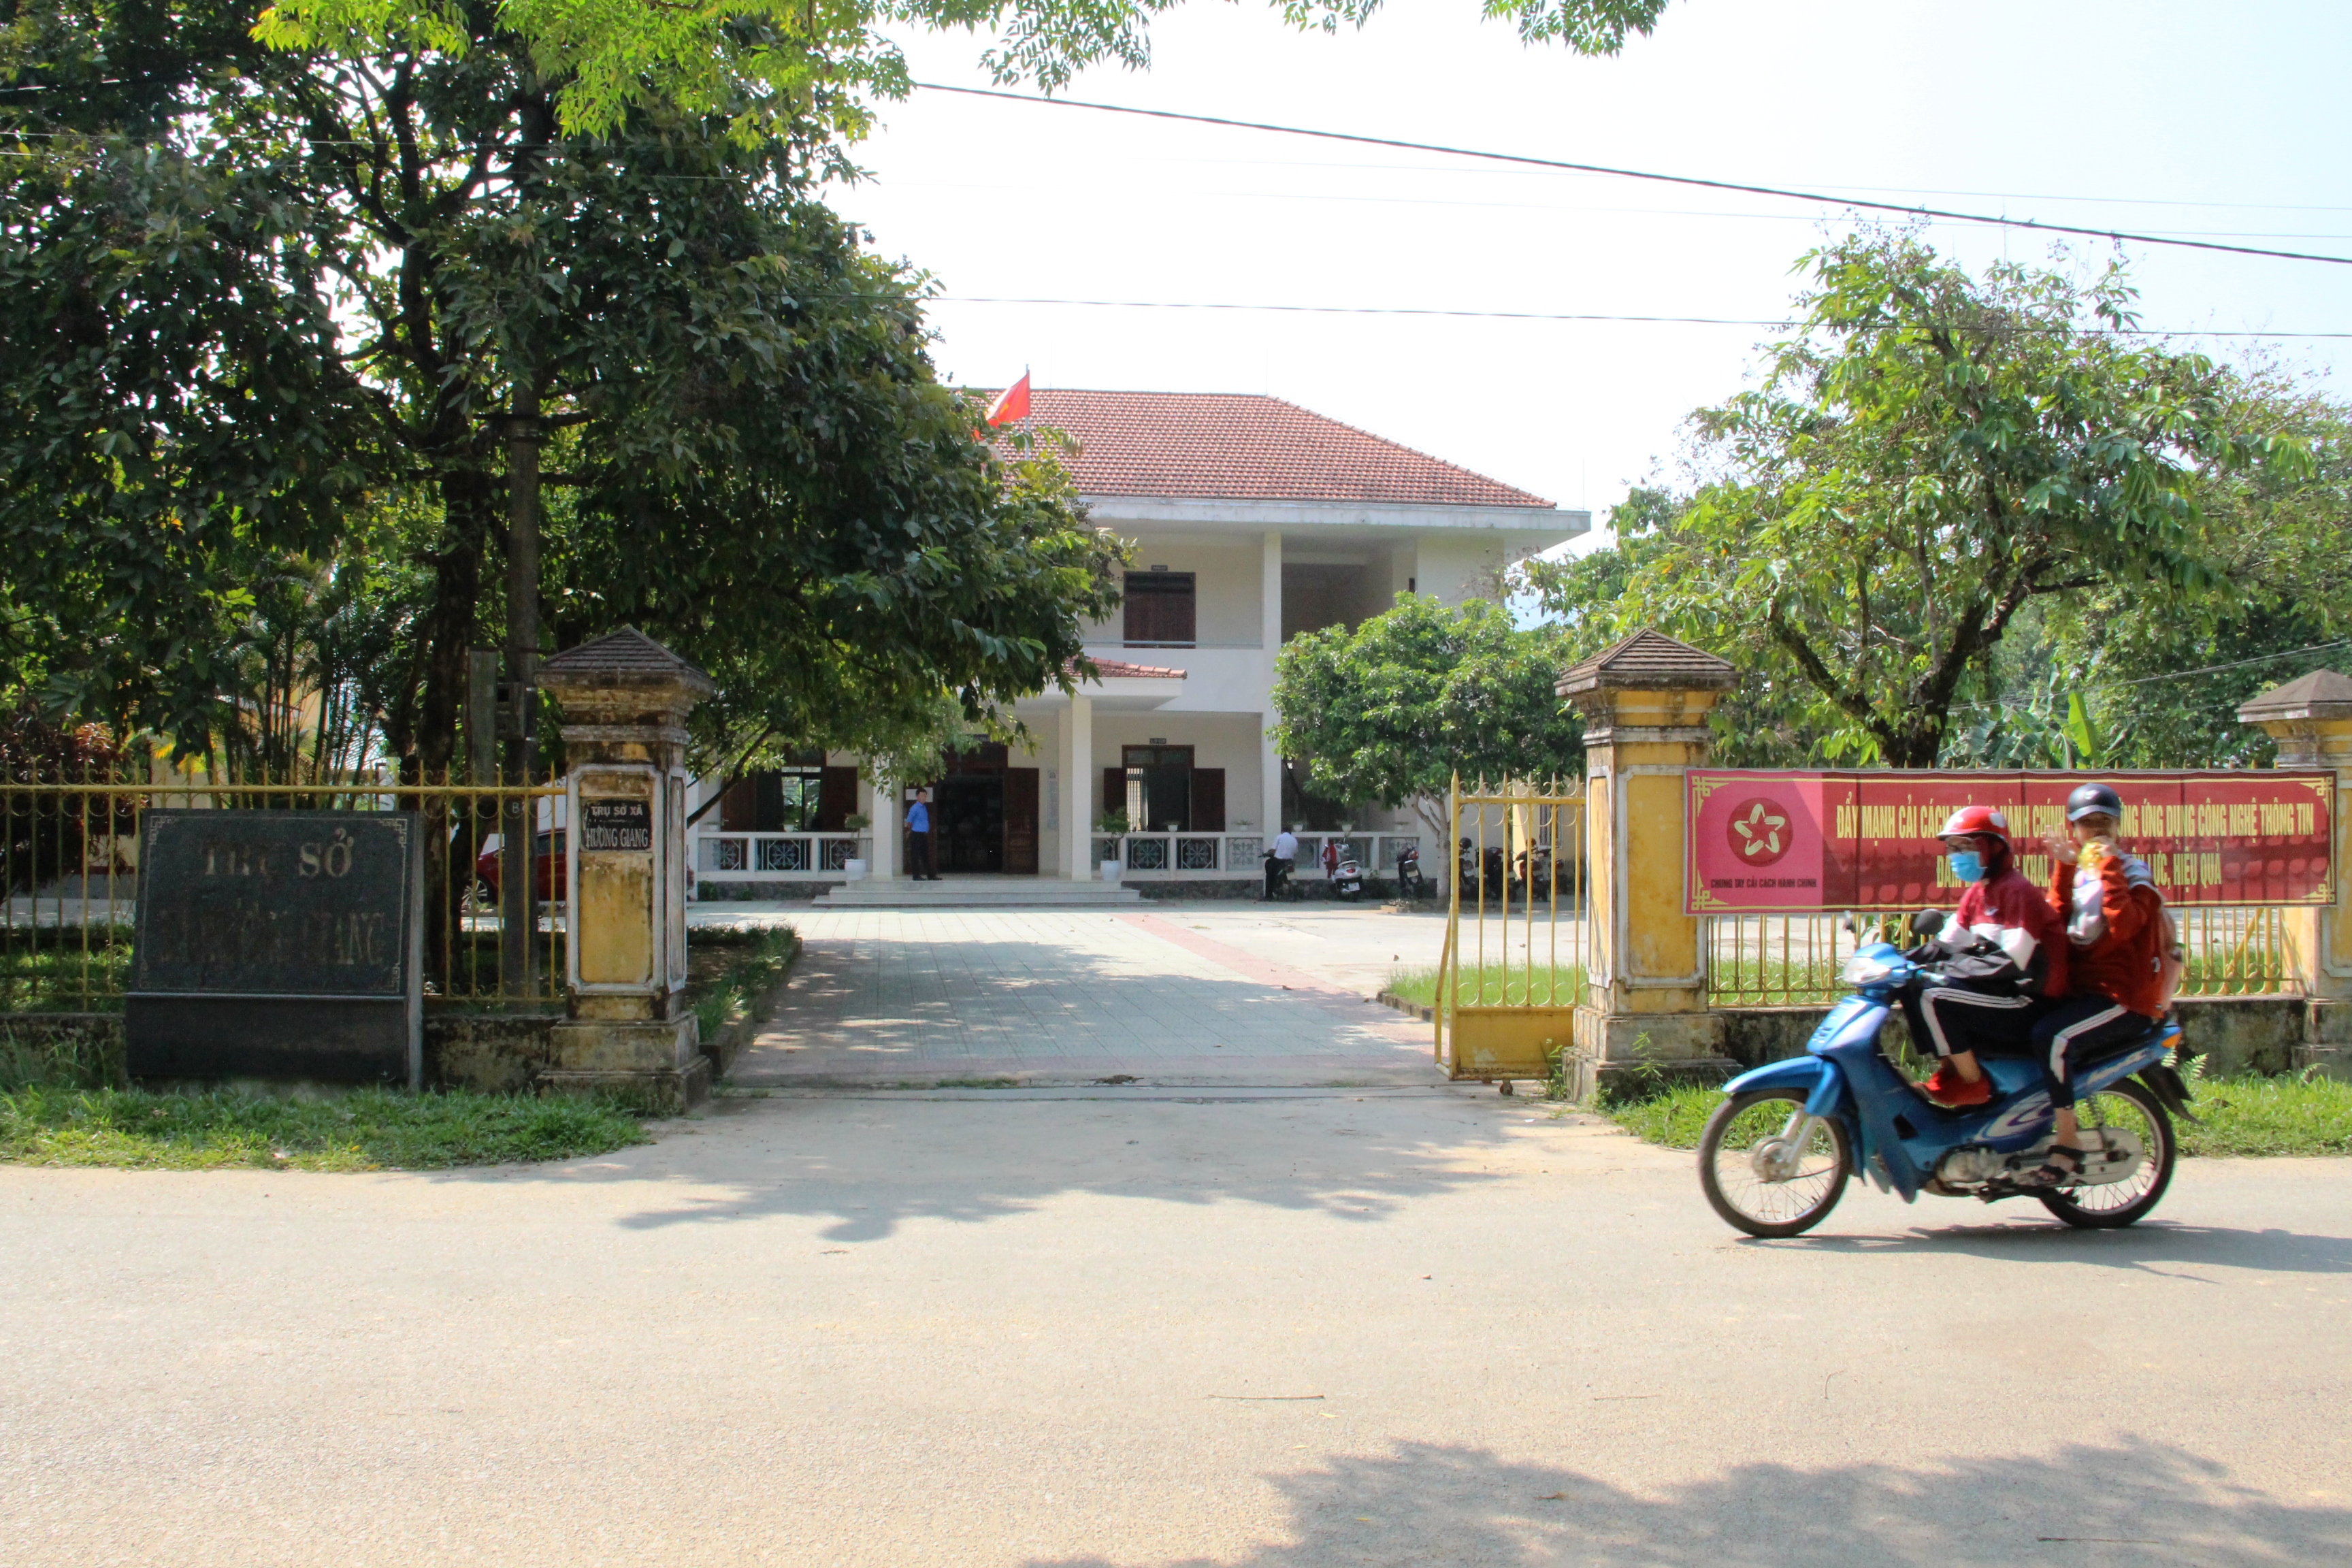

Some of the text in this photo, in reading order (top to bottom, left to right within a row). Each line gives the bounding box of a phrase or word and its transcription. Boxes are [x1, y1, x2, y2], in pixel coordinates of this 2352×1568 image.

[591, 806, 610, 817] TRỤ
[630, 804, 643, 815] XÃ
[1837, 791, 1859, 838] ĐẨY
[1862, 805, 1895, 846] MẠNH
[1898, 794, 1917, 838] CẢI
[2141, 798, 2163, 837] ỨNG
[2166, 804, 2195, 844] DỤNG
[2198, 797, 2227, 836] CÔNG
[2229, 797, 2257, 843] NGHỆ
[2259, 797, 2294, 836] THÔNG
[2296, 803, 2314, 835] TIN
[298, 827, 355, 877] SỞ
[620, 828, 649, 848] GIANG
[2173, 846, 2198, 893] HIỆU
[2200, 842, 2221, 889] QUẢ
